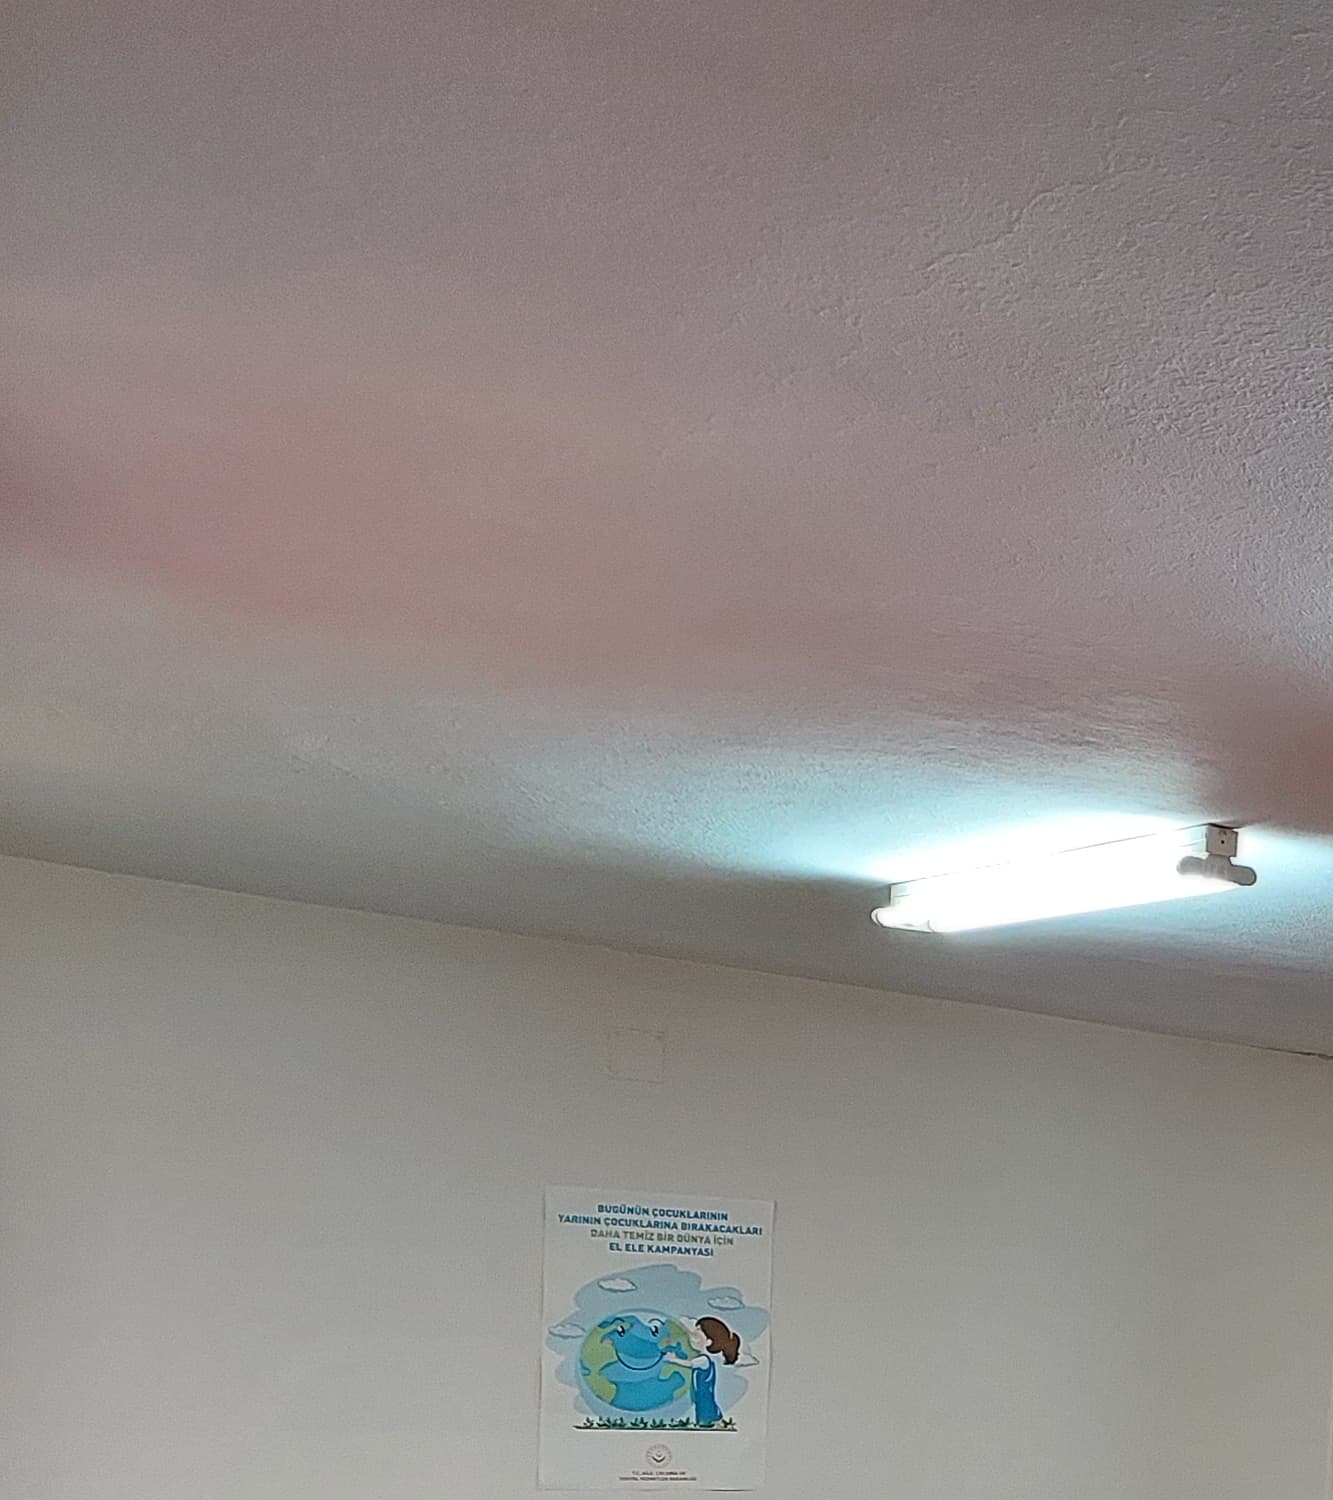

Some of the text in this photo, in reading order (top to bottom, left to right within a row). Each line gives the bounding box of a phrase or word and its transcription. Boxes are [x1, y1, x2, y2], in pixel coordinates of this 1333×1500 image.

[652, 1208, 729, 1221] ÇOCUKLARININ
[558, 1214, 763, 1235] YARININ ÇOCUKLARINA BIRAKACAKLARI
[590, 1229, 734, 1247] DAHA TEMİZ BİR DÜNYA İÇİN
[609, 1242, 714, 1257] EL ELE KAMPANYASI
